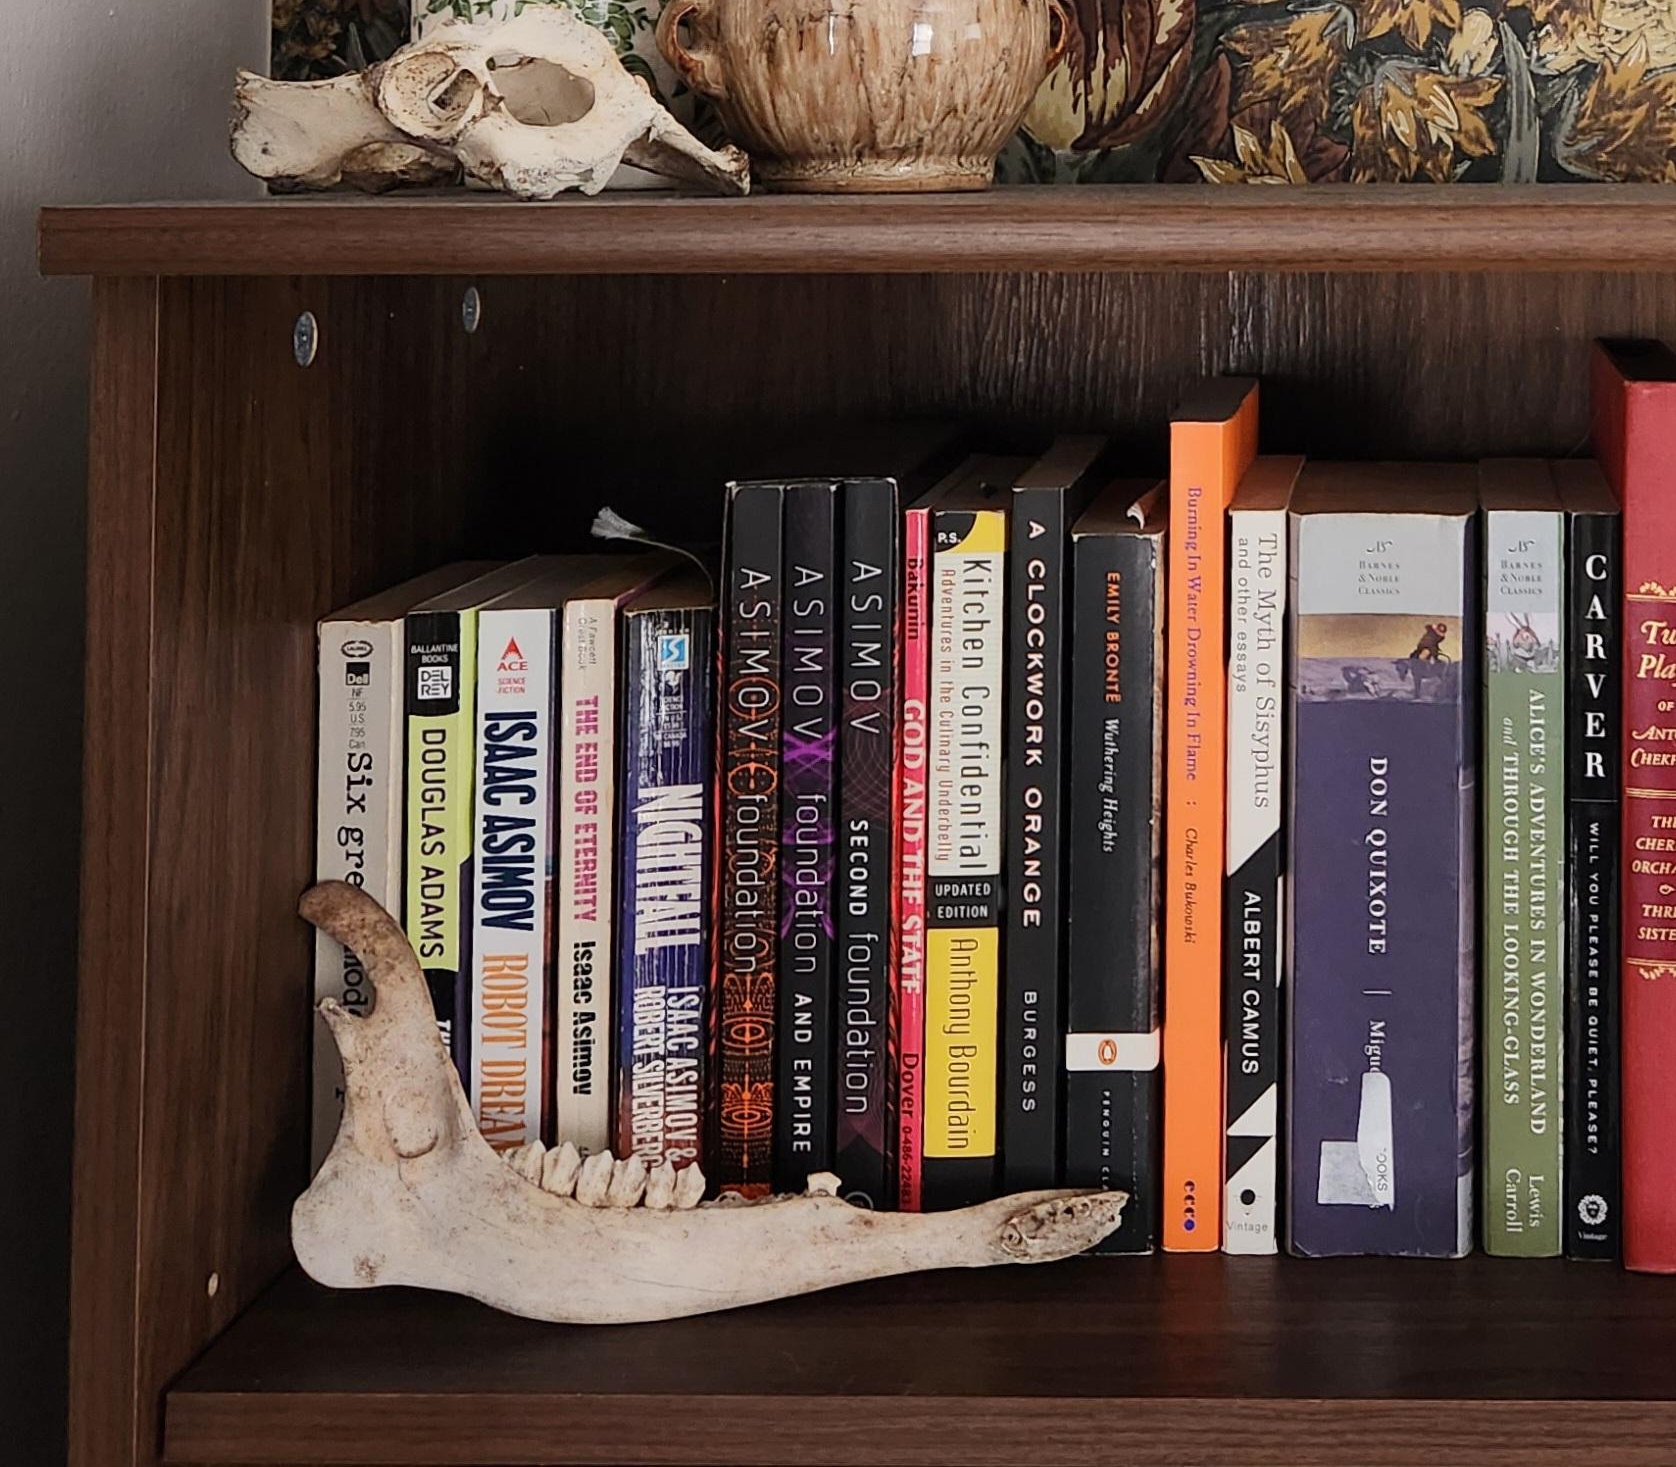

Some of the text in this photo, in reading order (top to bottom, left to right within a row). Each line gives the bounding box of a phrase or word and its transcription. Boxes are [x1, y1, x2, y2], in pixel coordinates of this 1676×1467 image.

[938, 532, 962, 544] P.S.
[1358, 560, 1401, 570] BARNES
[1368, 573, 1400, 583] NOBLE
[1500, 560, 1543, 570] BARNES
[1511, 573, 1543, 583] NOBLE
[1105, 571, 1121, 624] EMILY
[1184, 487, 1202, 781] Burning Drowning Flame
[1233, 538, 1252, 693] and other essays
[1358, 586, 1401, 596] CLASSICS
[1500, 586, 1543, 596] CLASSICS
[347, 673, 369, 684] Dell
[411, 644, 458, 654] BALLANTINE
[421, 655, 449, 664] BOOKS
[421, 670, 450, 681] DEL
[421, 684, 450, 696] REY
[497, 662, 528, 671] ACE
[498, 677, 526, 685] SCIENCE
[1251, 533, 1278, 809] The Myth of Sisyphus
[1584, 554, 1608, 778] CARVER
[934, 569, 956, 863] Adventures in the Culinary Underbelly
[959, 560, 992, 870] Kitchen Confidential
[1022, 520, 1047, 928] A CLOCKWORK ORANGE
[1657, 700, 1676, 712] OF
[346, 753, 373, 815] Six
[574, 695, 599, 922] THE END OF ETERNITY
[734, 568, 772, 973] ASIMOV foundation
[1097, 718, 1120, 854] Wuthering Heights
[419, 729, 446, 958] DOUGLAS ADAMS
[481, 711, 538, 932] ISAAC ASIMOV
[632, 783, 704, 956] NIGHTFALL
[792, 566, 827, 1153] ASIMOV foundation AND EMPIRE
[845, 561, 883, 1114] ASIMOV SECOND foundation
[901, 699, 926, 996] GOD AND THE STATE
[1364, 756, 1389, 955] DON QUIXOTE
[1503, 751, 1520, 915] THROUGH THE
[935, 883, 992, 897] UPDATED
[937, 905, 989, 920] EDITION
[1184, 827, 1199, 945] Charles Bukowski
[481, 953, 529, 1049] ROBOT
[1240, 890, 1262, 1075] ALBERT CAMUS
[1529, 782, 1547, 1135] ADVENTURES IN WONDERLAND
[1586, 822, 1600, 1155] WILL YOU PLEASE BE PLEASE?
[573, 1011, 596, 1096] Asimov
[633, 985, 666, 1056] ROBERT
[665, 986, 700, 1132] ISAAC ASIMOV
[941, 937, 979, 1151] Anthony Bourdain
[1021, 990, 1039, 1113] BURGESS
[901, 1053, 920, 1119] Dover
[1101, 1089, 1111, 1158] PENGUIN
[1504, 1167, 1523, 1233] Carroll
[1528, 1174, 1545, 1228] Lewis
